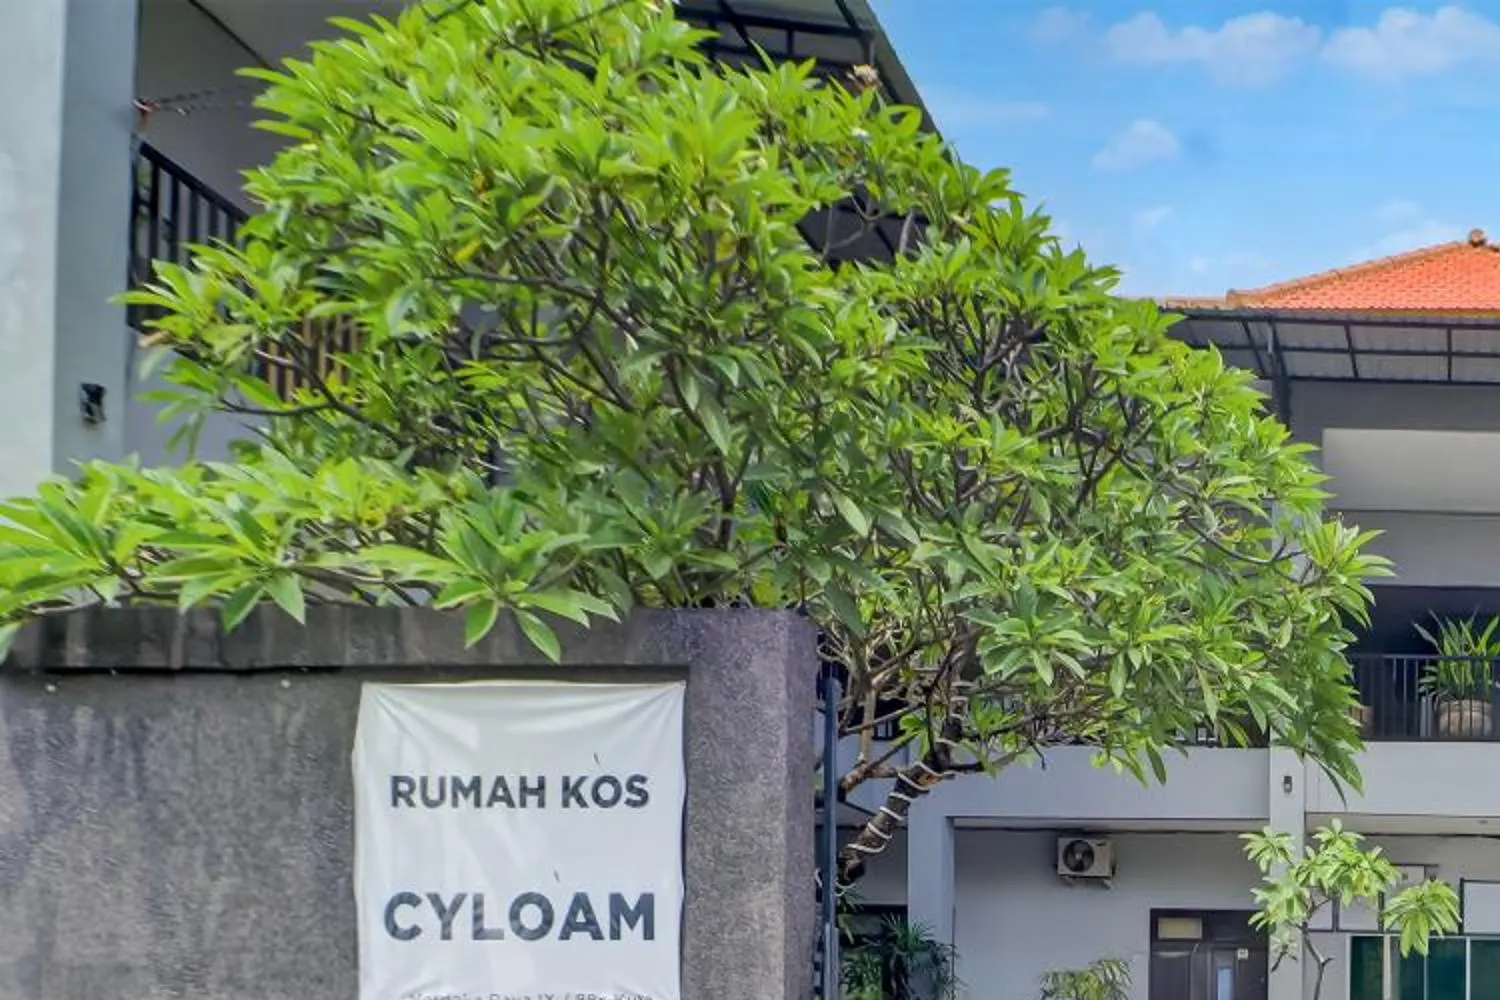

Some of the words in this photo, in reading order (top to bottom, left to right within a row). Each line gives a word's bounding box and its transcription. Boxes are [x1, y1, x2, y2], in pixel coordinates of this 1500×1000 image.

[390, 775, 546, 809] RUMAH
[561, 774, 650, 809] KOS
[383, 891, 655, 942] CYLOAM
